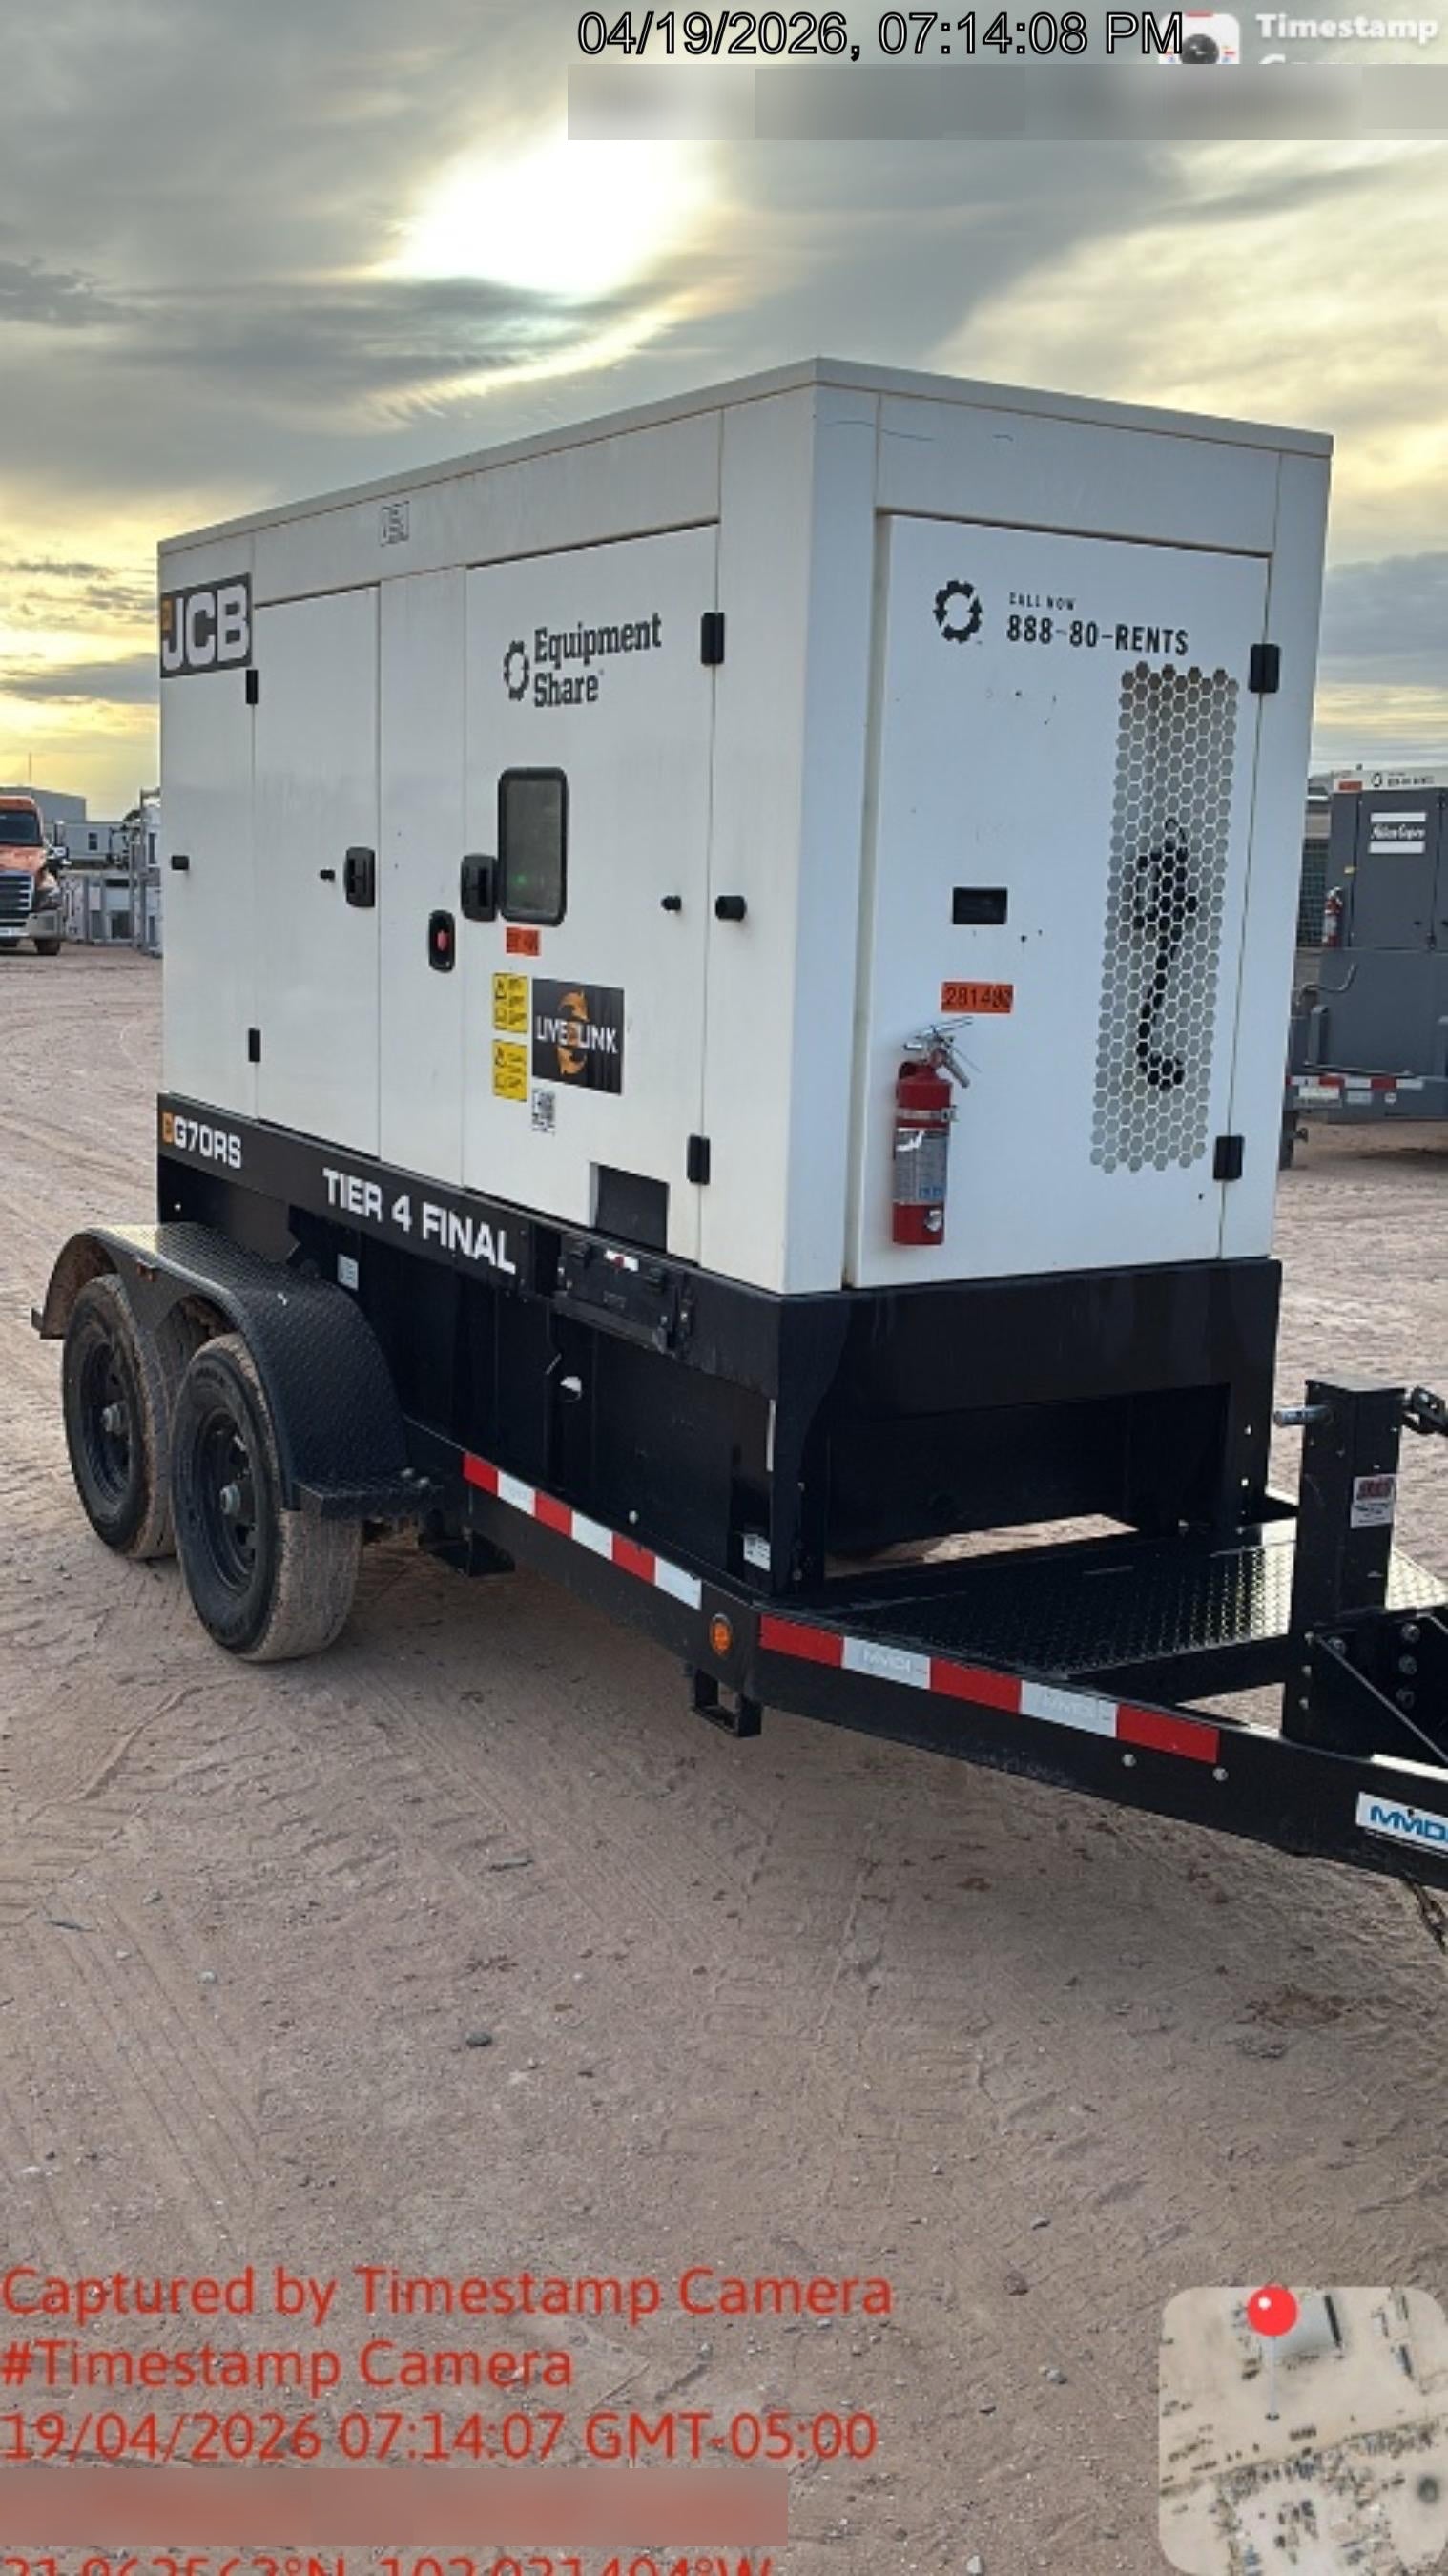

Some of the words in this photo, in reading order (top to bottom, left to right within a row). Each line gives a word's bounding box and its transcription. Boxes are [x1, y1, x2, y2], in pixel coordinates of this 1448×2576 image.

[1009, 592, 1041, 608] CALL
[1046, 595, 1075, 611] NOW
[162, 584, 250, 671] JCB
[534, 612, 662, 670] Equipment
[1007, 614, 1189, 656] 888-80-RENTS
[534, 672, 599, 708] Share
[322, 1167, 383, 1223] TIER
[391, 1195, 412, 1234] 4
[422, 1201, 516, 1275] FINAL
